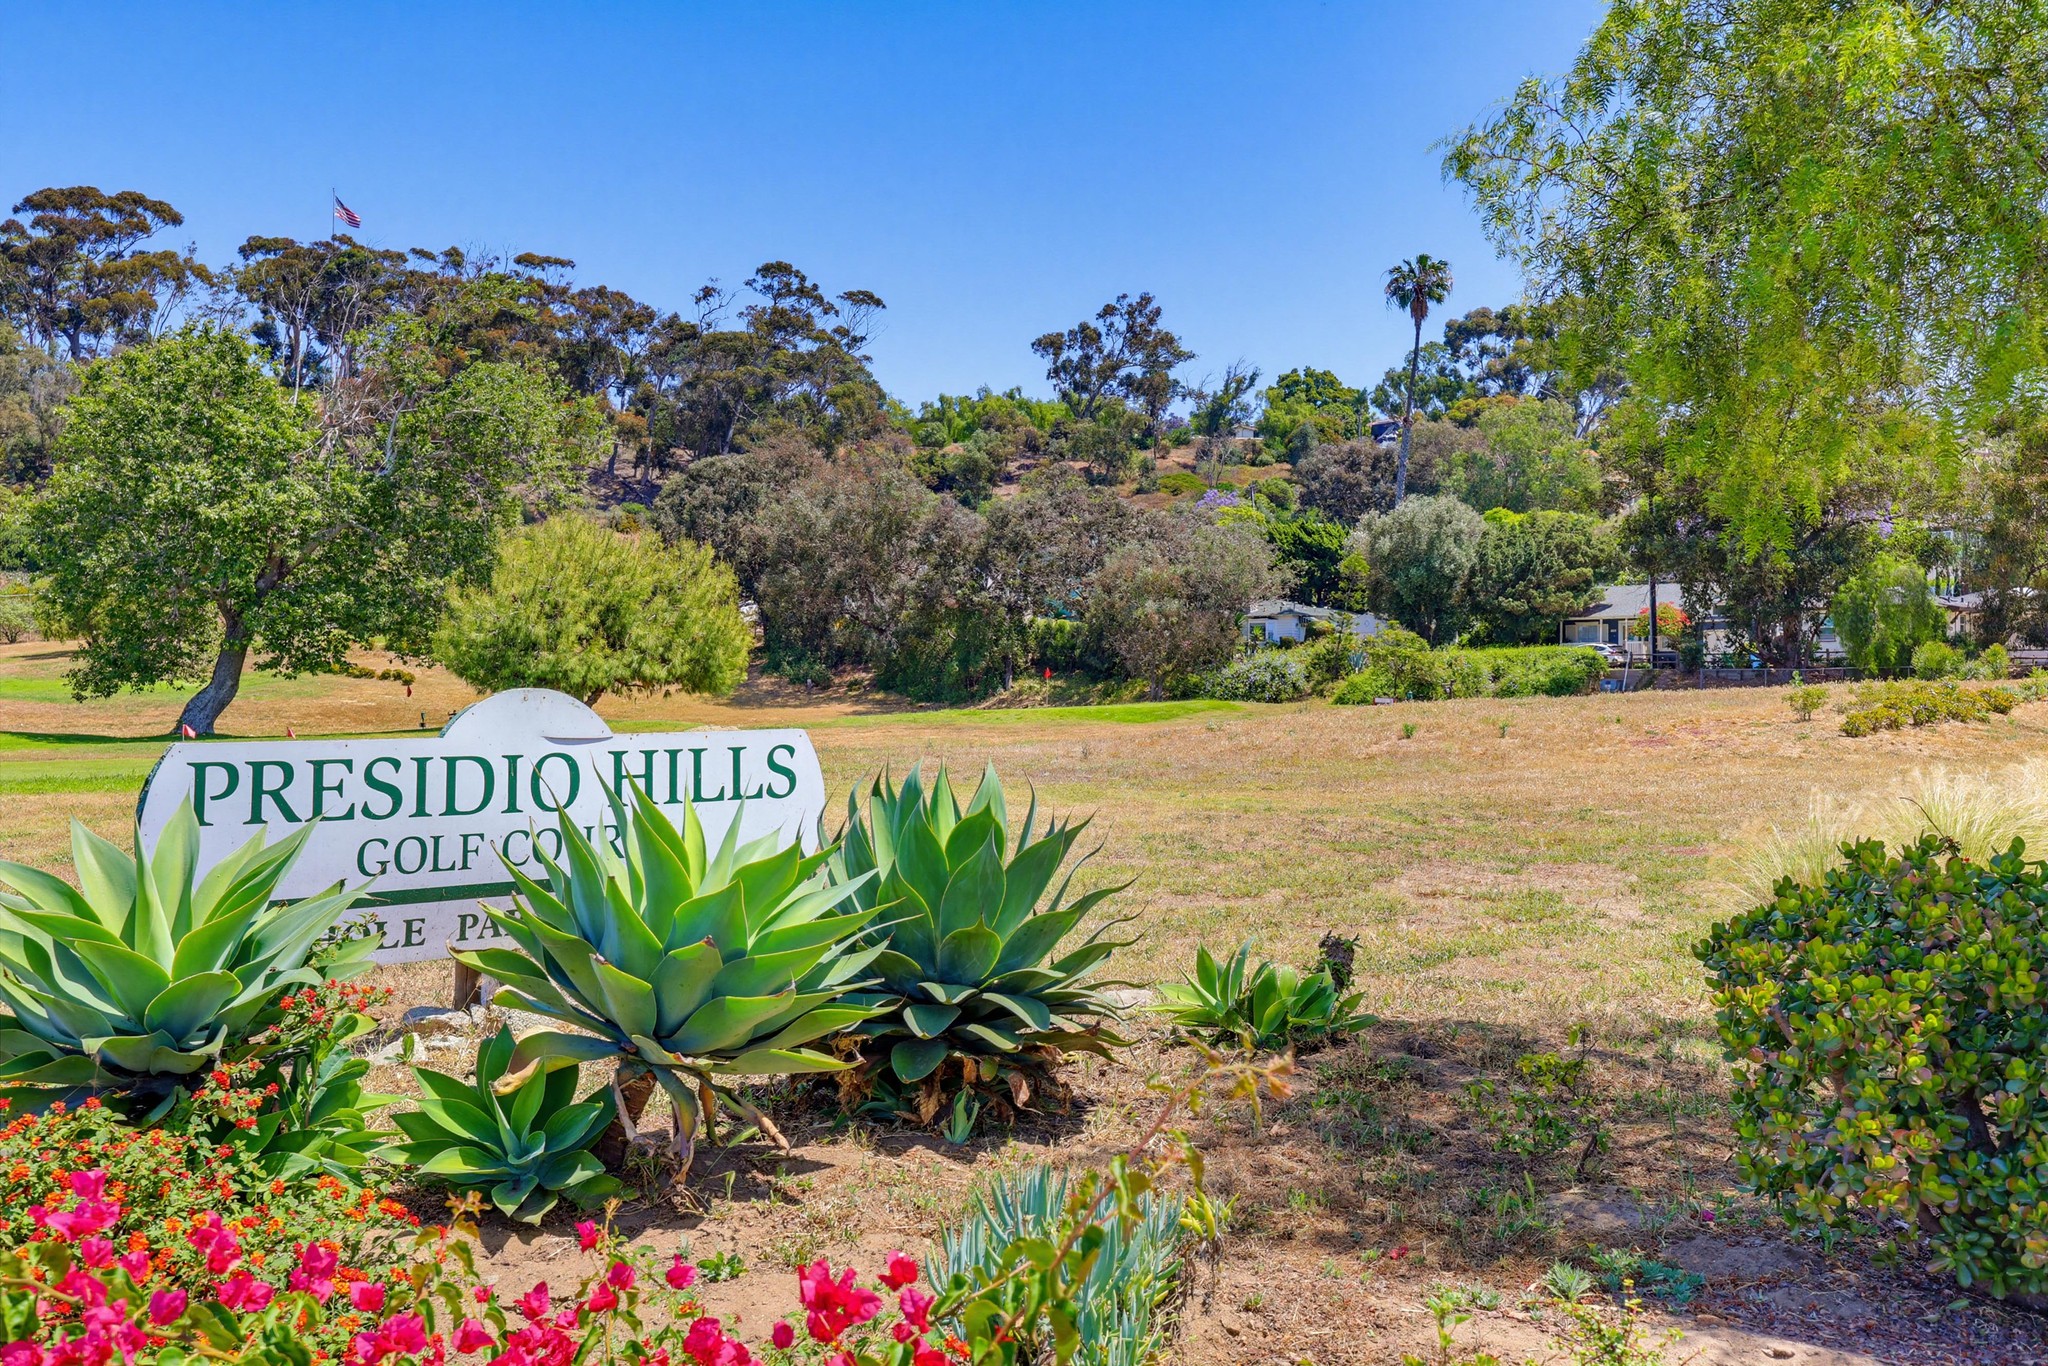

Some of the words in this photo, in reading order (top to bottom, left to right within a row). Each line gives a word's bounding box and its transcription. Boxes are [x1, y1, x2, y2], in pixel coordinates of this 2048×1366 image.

[186, 752, 580, 826] PRESIDIO
[608, 744, 797, 807] HILLS
[357, 833, 485, 877] GOLF
[503, 825, 625, 867] COR
[456, 909, 520, 942] PA
